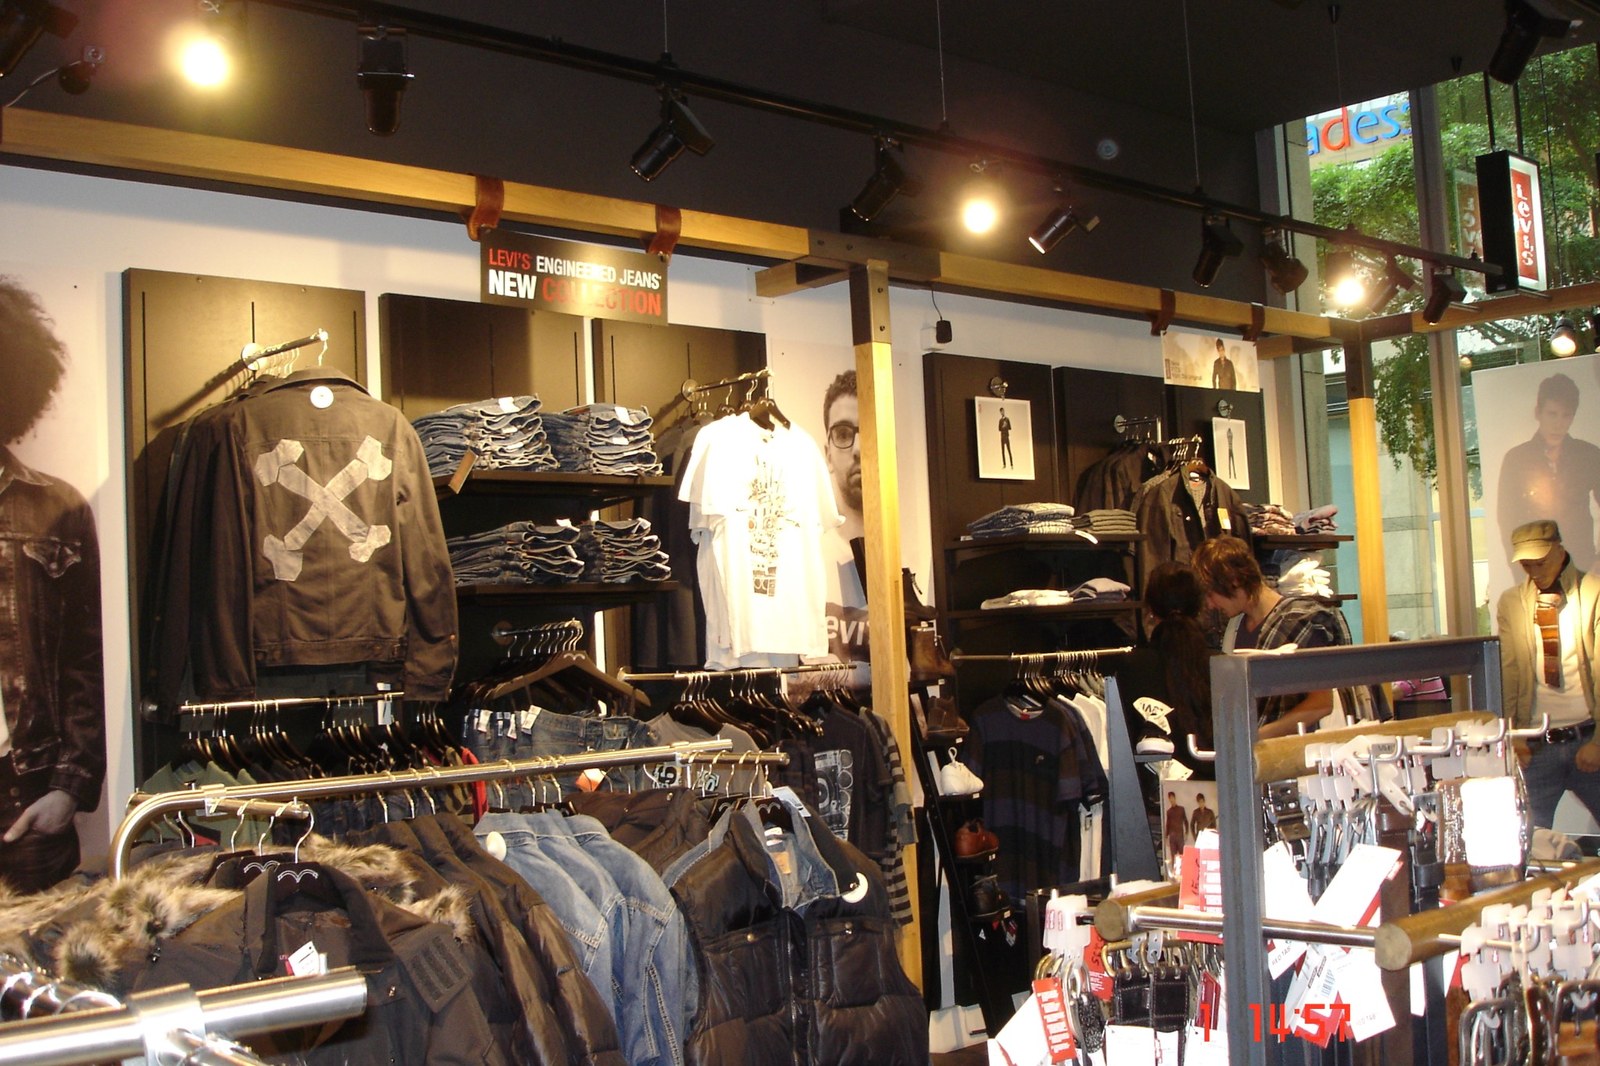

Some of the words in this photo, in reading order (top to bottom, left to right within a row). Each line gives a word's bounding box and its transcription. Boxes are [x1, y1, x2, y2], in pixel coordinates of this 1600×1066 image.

[488, 248, 531, 270] LEVI'S
[536, 256, 616, 283] ENGINEERED
[620, 269, 661, 290] JEANS
[488, 269, 537, 300] NEW
[825, 615, 870, 646] evi
